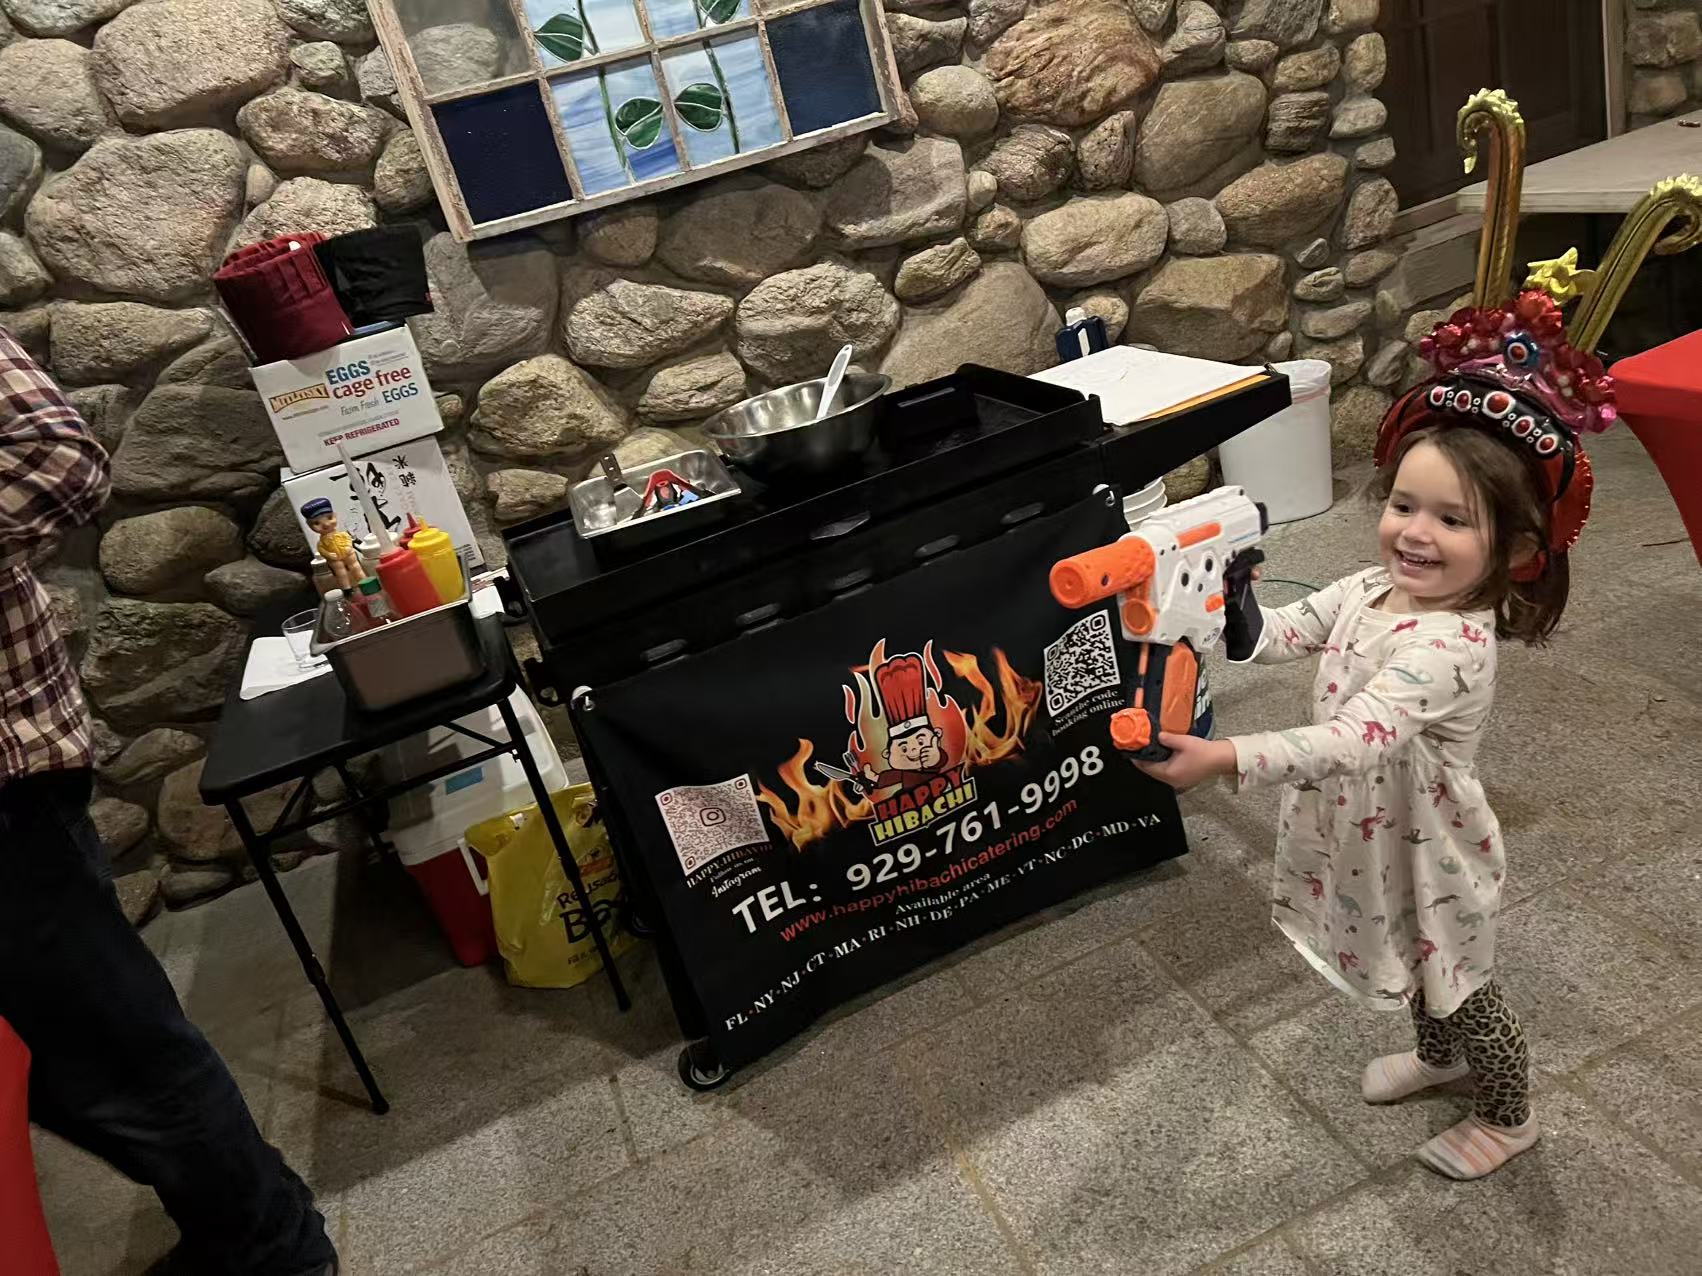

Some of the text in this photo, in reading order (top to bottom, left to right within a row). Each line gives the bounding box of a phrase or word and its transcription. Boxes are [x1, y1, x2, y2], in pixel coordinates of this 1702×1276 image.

[325, 360, 371, 385] EGGS
[332, 366, 412, 400] cage free
[382, 382, 419, 403] EGGS
[323, 434, 344, 447] KEEP
[345, 418, 400, 440] REFRIGERATED
[1089, 699, 1126, 713] online
[1091, 690, 1119, 703] code
[877, 766, 962, 821] HAPPY
[873, 782, 974, 841] HIBACHI
[731, 745, 1105, 934] TEL: 929-761-9998
[712, 866, 762, 898] Instagram
[780, 799, 1078, 942] www.happyhibachicatering.com
[895, 872, 990, 915] Available area
